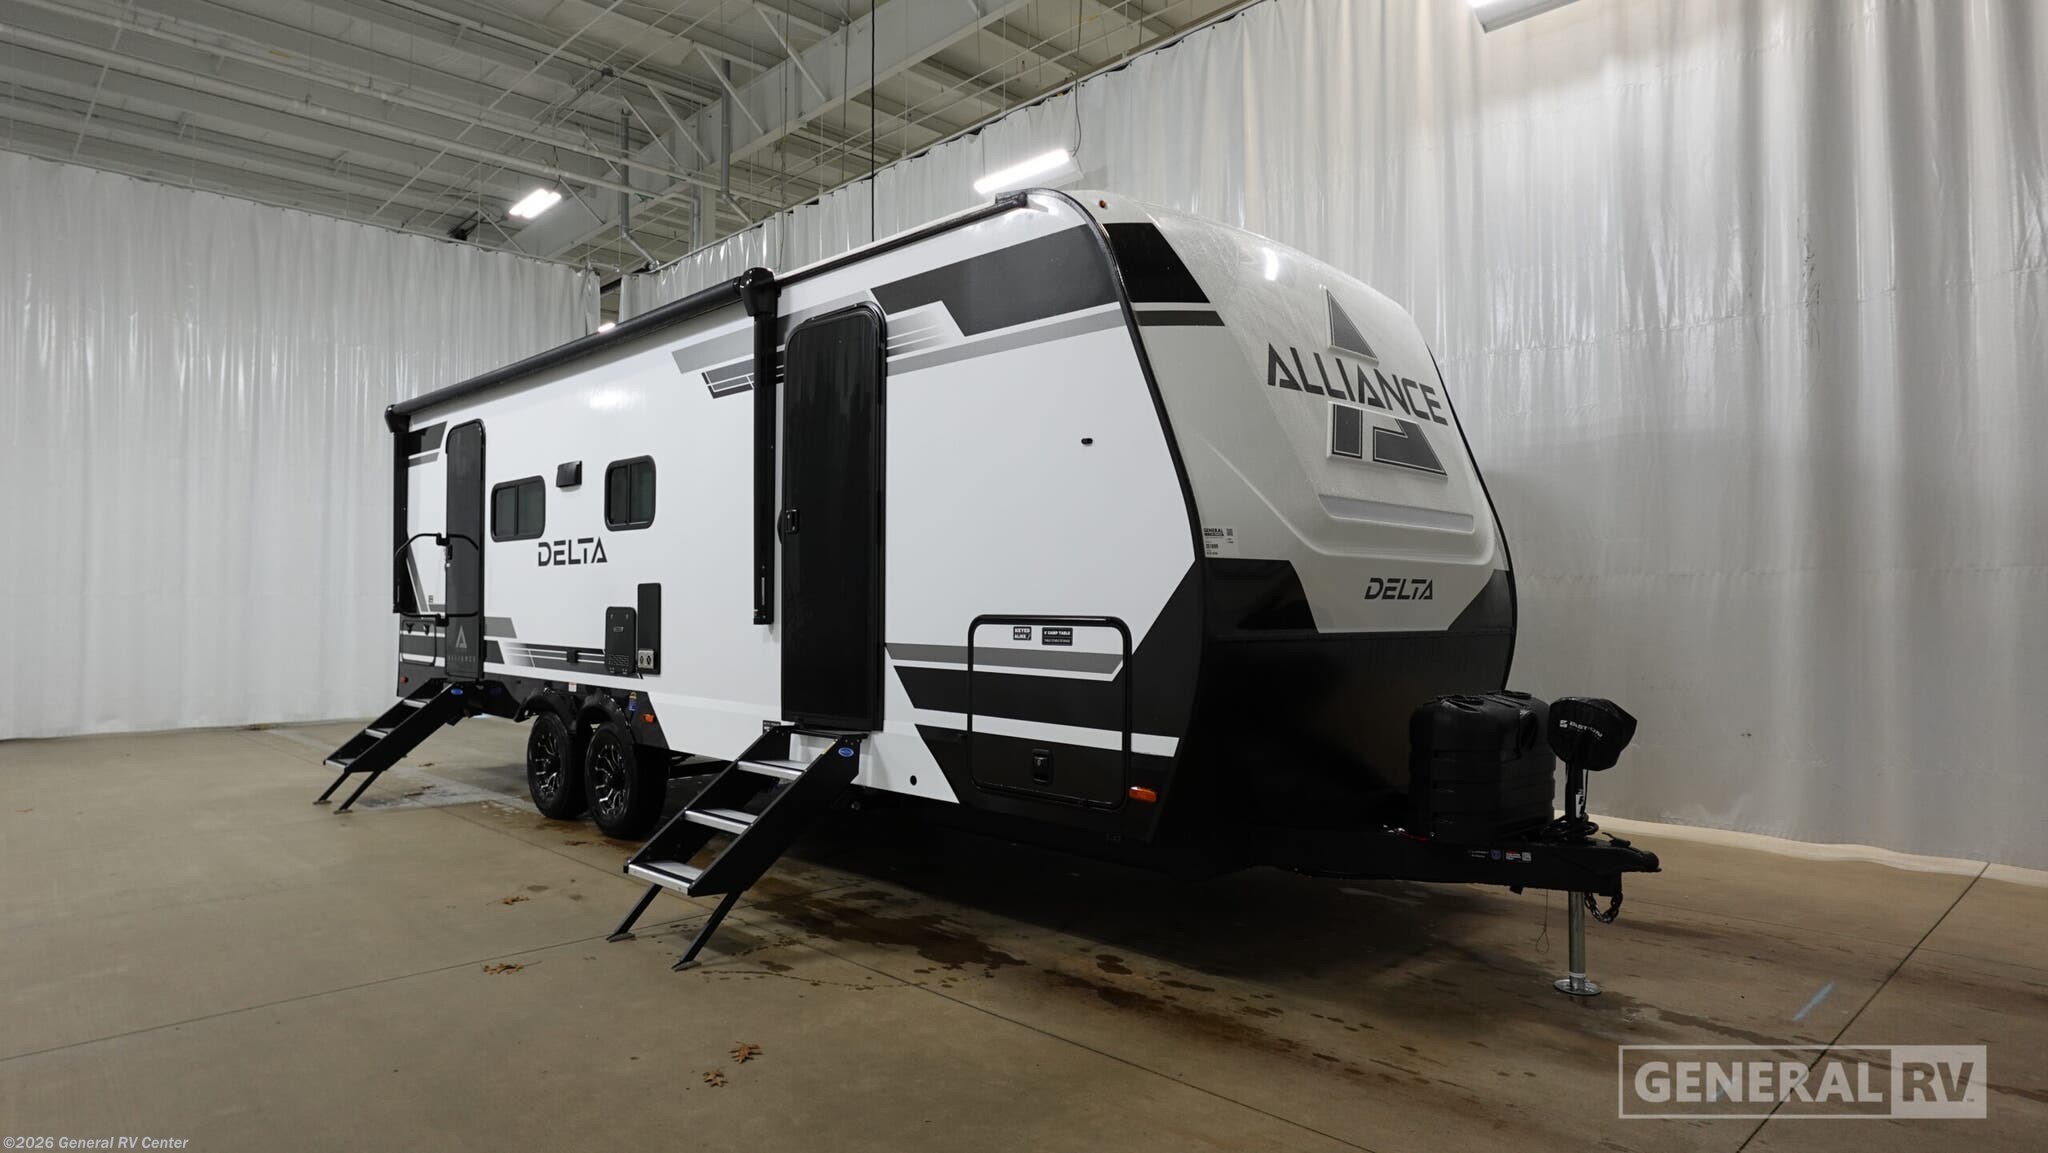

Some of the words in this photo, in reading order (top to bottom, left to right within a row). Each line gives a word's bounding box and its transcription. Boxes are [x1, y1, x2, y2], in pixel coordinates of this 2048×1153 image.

[1267, 343, 1448, 426] ALLIANCE
[538, 537, 608, 567] DELTA
[1364, 577, 1434, 600] DELTA
